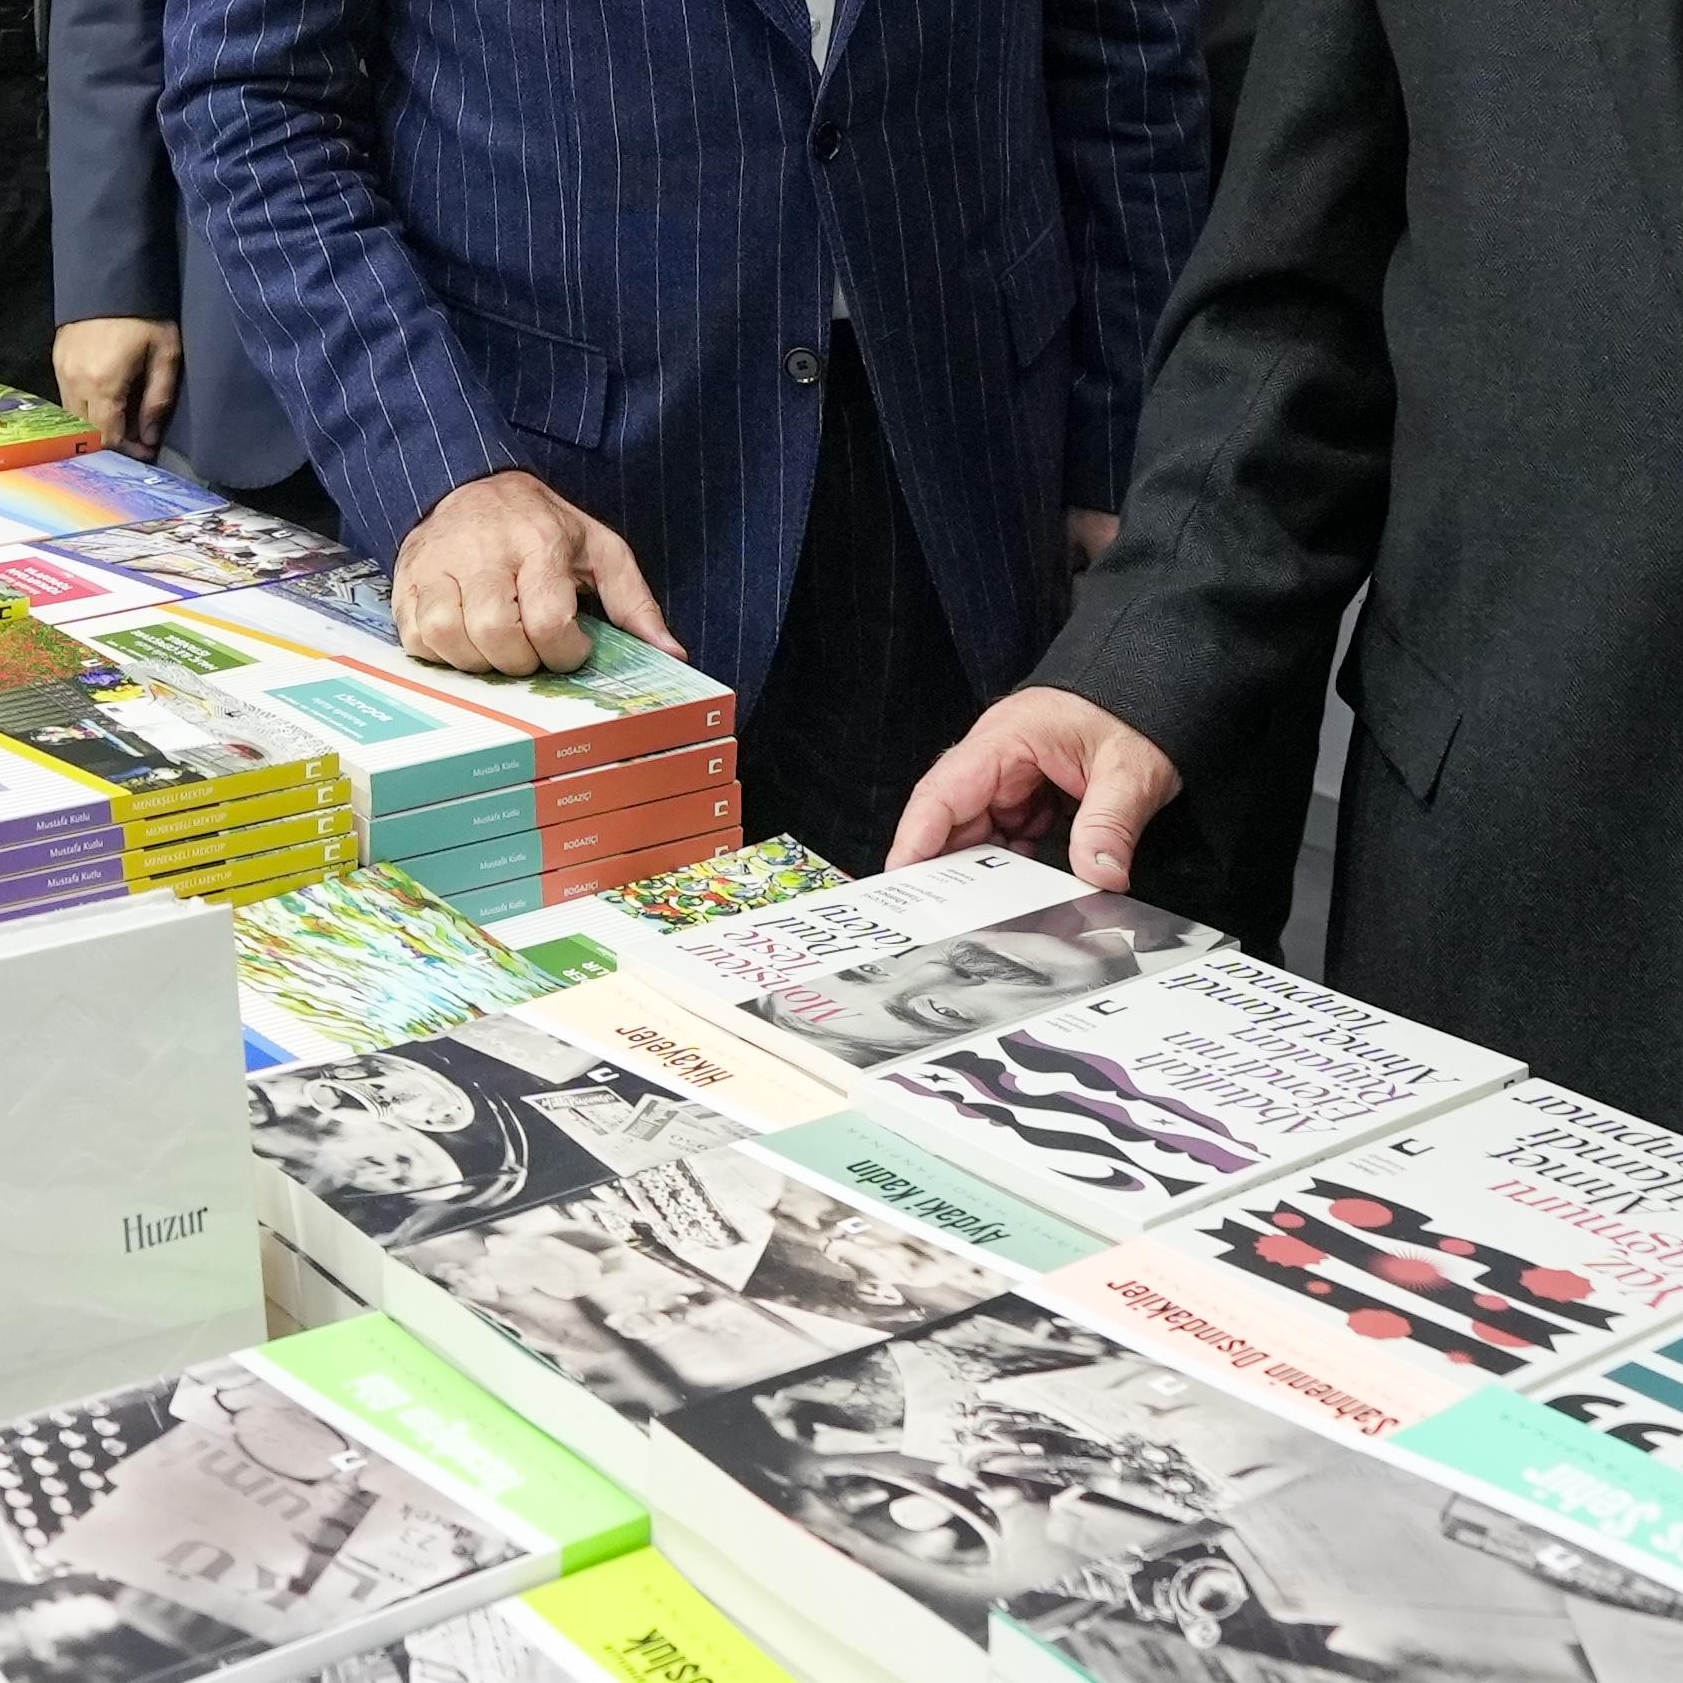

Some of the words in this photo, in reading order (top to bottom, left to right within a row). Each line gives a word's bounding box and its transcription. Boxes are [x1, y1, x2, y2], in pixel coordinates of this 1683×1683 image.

[556, 742, 592, 759] BOĞAZİÇİ
[36, 815, 68, 832] Mustafa
[69, 811, 91, 825] Kutlu
[557, 791, 593, 807] BOĞAZİÇİ
[49, 842, 81, 859] Mustafa
[82, 838, 104, 852] Kutlu
[563, 834, 600, 851] BOĞAZİÇİ
[46, 874, 78, 889] Mustafa
[80, 869, 102, 883] Kutlu
[564, 880, 600, 897] BOĞAZİÇİ
[723, 929, 825, 978] Teste
[753, 916, 863, 957] Paul
[808, 903, 927, 960] Valéry
[675, 942, 863, 1025] Monsieur
[1158, 972, 1316, 1033] Hamdi
[1203, 959, 1391, 1038] Tanpınar
[614, 1025, 734, 1088] Hikâyeler
[1227, 1026, 1419, 1109] Rüyaları
[1316, 1025, 1463, 1085] Ahmet
[1131, 1050, 1340, 1136] Abdullah
[845, 1158, 920, 1203] Kadın
[1483, 1145, 1680, 1216] Ahmet
[121, 1204, 210, 1255] Huzur
[903, 1196, 1012, 1246] Aydaki
[1105, 1279, 1271, 1369] Dışındakiler
[1263, 1362, 1401, 1436] Sahnenin
